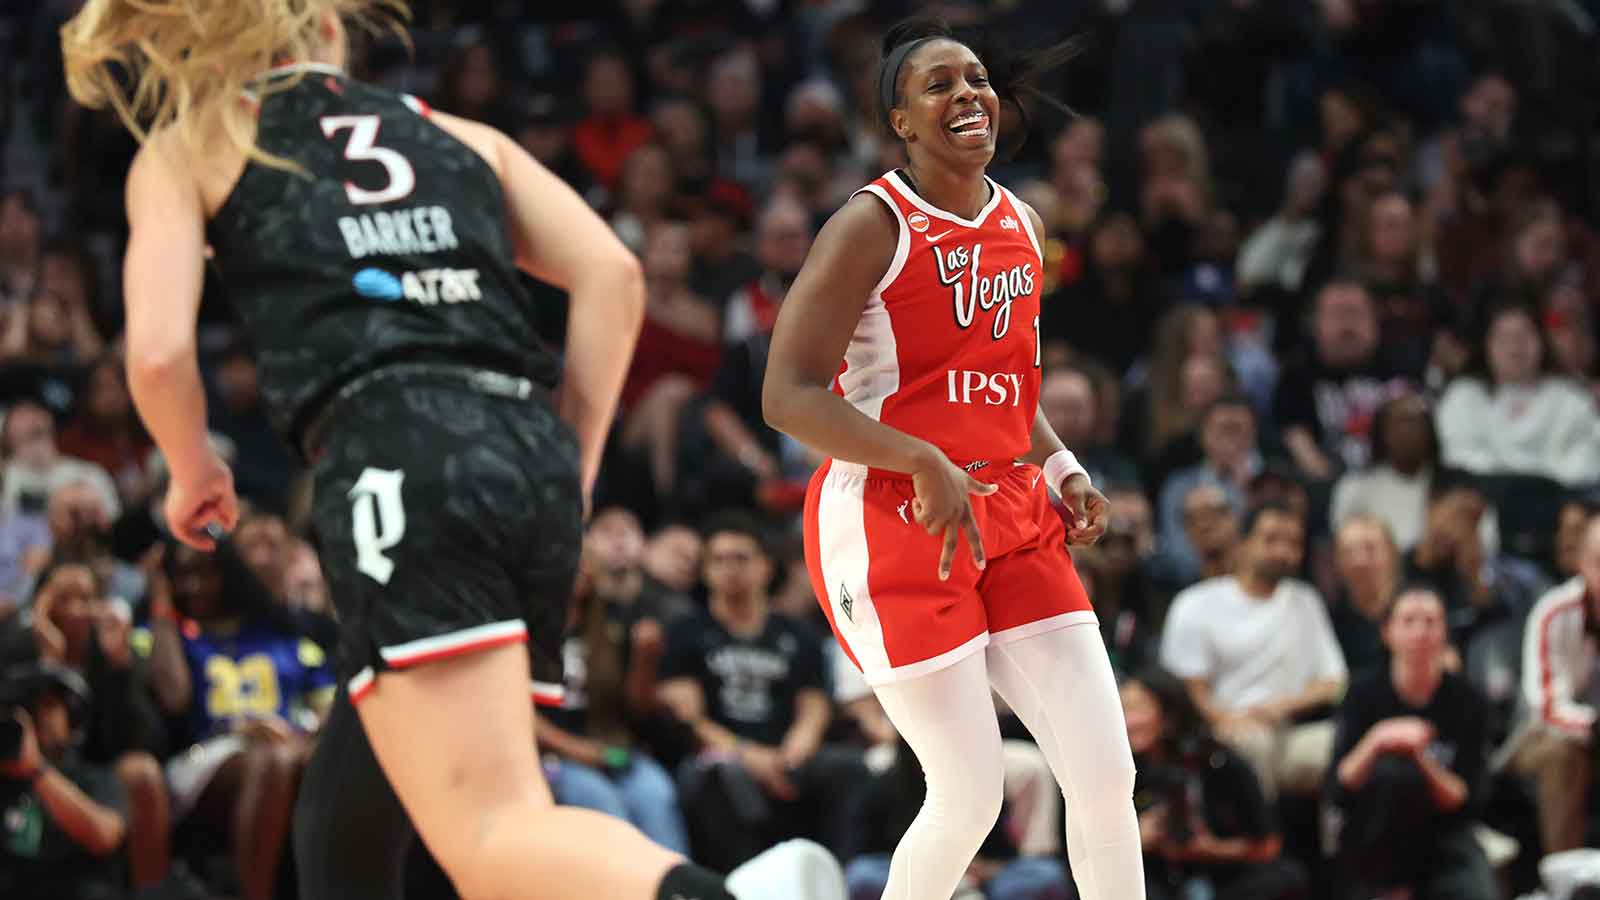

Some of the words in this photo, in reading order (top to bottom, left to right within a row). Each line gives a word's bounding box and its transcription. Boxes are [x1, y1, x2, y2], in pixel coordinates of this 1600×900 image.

[319, 114, 416, 205] 3
[337, 206, 459, 259] BARKER
[1000, 215, 1020, 233] ally
[932, 244, 969, 285] Las
[953, 243, 1035, 341] Vegas
[947, 369, 1025, 407] IPSY
